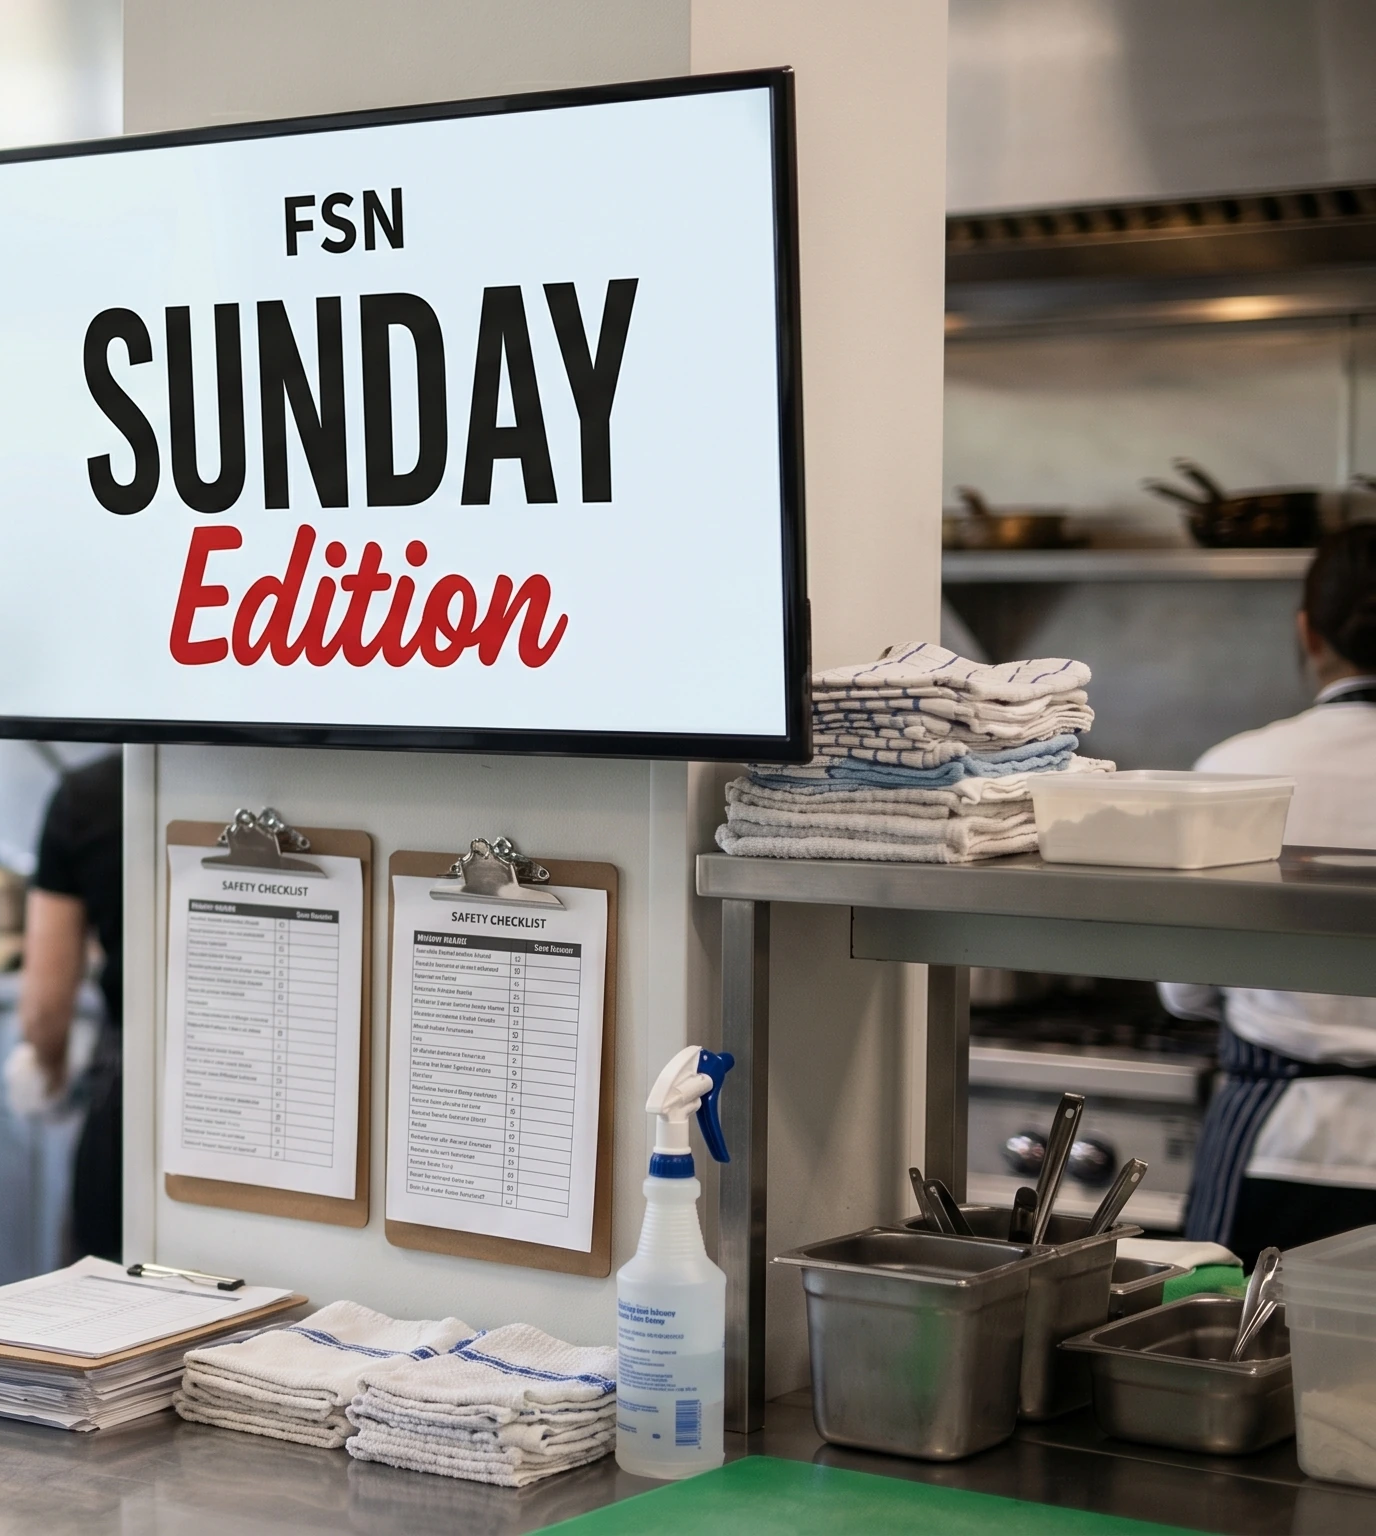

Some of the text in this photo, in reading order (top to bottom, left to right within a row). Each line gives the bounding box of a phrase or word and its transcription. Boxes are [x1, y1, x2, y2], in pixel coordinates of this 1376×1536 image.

[284, 187, 405, 256] FSN
[83, 277, 639, 516] SUNDAY
[169, 523, 569, 669] Edition
[222, 880, 309, 897] SAFETY CHECKLIST
[451, 911, 547, 929] SAFETY CHECKLIST
